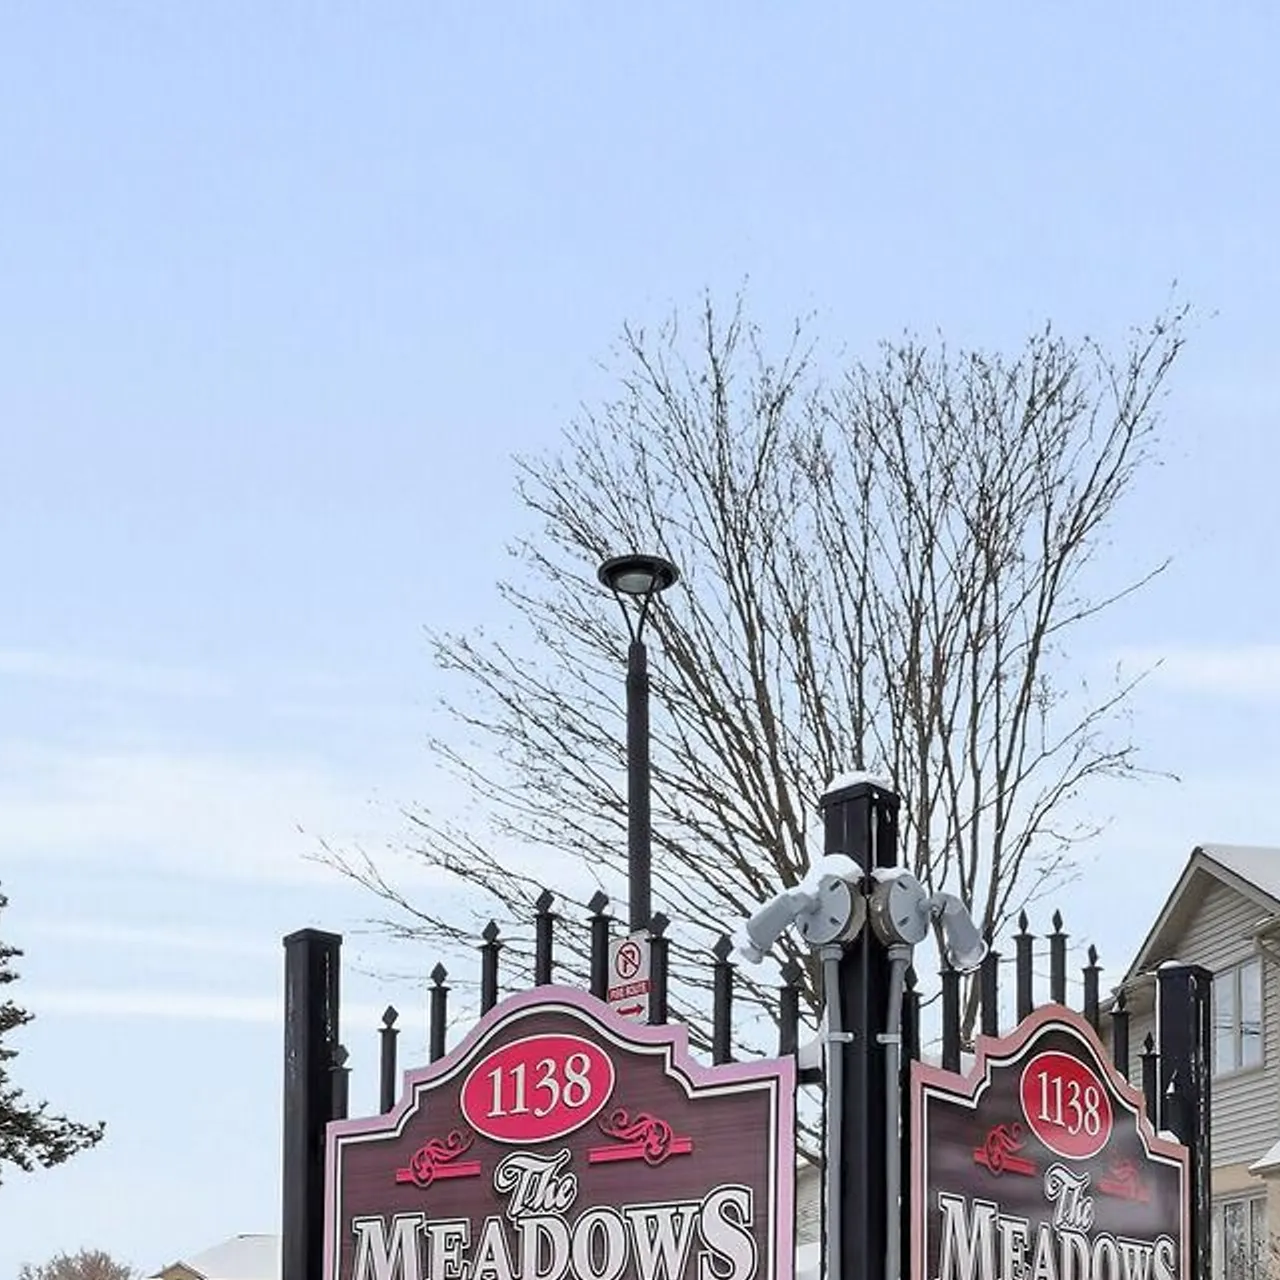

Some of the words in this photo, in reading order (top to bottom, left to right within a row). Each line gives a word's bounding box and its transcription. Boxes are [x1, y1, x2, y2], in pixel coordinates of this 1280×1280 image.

[485, 1053, 592, 1118] 1138
[1037, 1071, 1101, 1136] 1138
[494, 1149, 577, 1216] The
[1045, 1163, 1094, 1231] The
